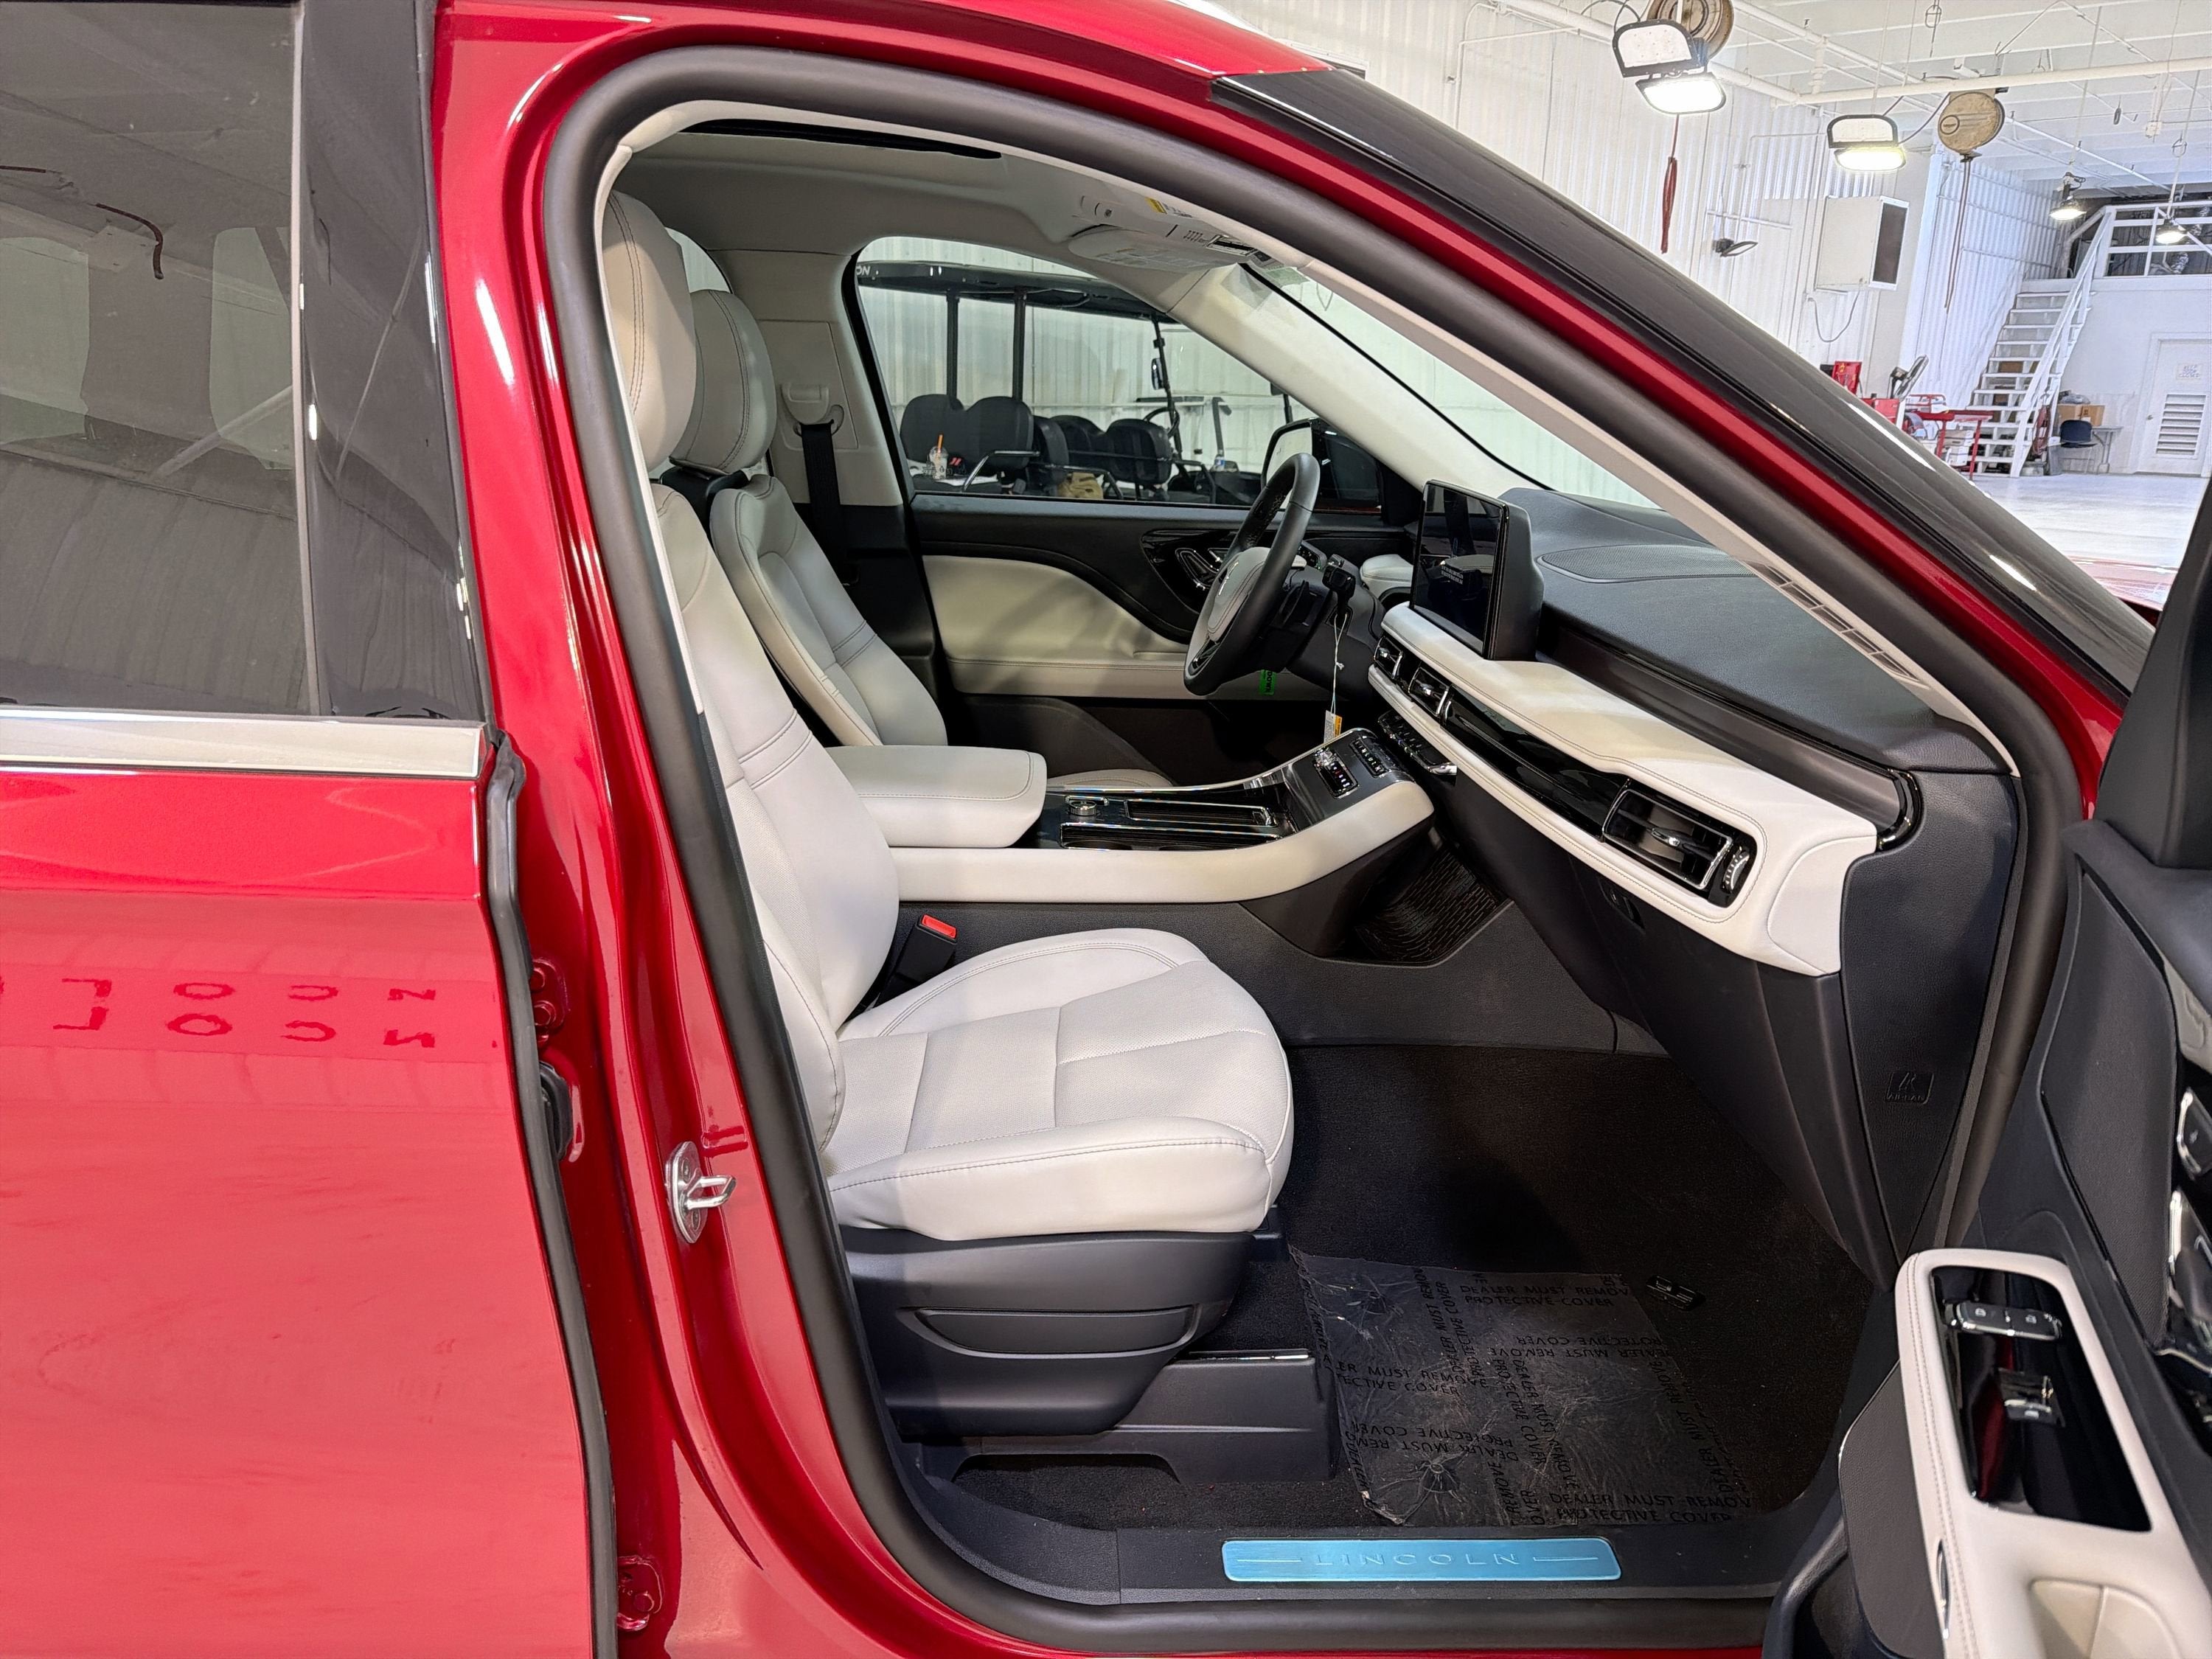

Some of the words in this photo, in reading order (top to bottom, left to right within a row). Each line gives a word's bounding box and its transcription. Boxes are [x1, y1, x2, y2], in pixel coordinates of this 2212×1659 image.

[1436, 1281, 1458, 1313] COVER
[1460, 1285, 1515, 1294] DEALER
[1524, 1285, 1565, 1295] MUST
[1464, 1295, 1557, 1305] PROTECTIVE
[1561, 1295, 1615, 1307] COVER
[1425, 1303, 1447, 1331] MUST
[1517, 1335, 1570, 1346] COVER
[1440, 1336, 1465, 1373] DEALER
[1489, 1347, 1555, 1357] REMOVE
[1565, 1348, 1608, 1357] MUST
[1368, 1366, 1410, 1378] MUST
[1404, 1382, 1462, 1397] COVER
[1649, 1361, 1684, 1404] REMOVE
[1512, 1360, 1540, 1398] DEALER
[1531, 1404, 1556, 1433] MUST
[1676, 1410, 1706, 1440] MUST
[1402, 1440, 1449, 1453] MUST
[1520, 1425, 1547, 1464] COVER
[1698, 1448, 1734, 1492] DEALER
[1487, 1461, 1520, 1514] REMOVE
[1549, 1492, 1614, 1505] DEALER
[1624, 1494, 1675, 1505] MUST
[1315, 1552, 1520, 1567] LINCOLN
